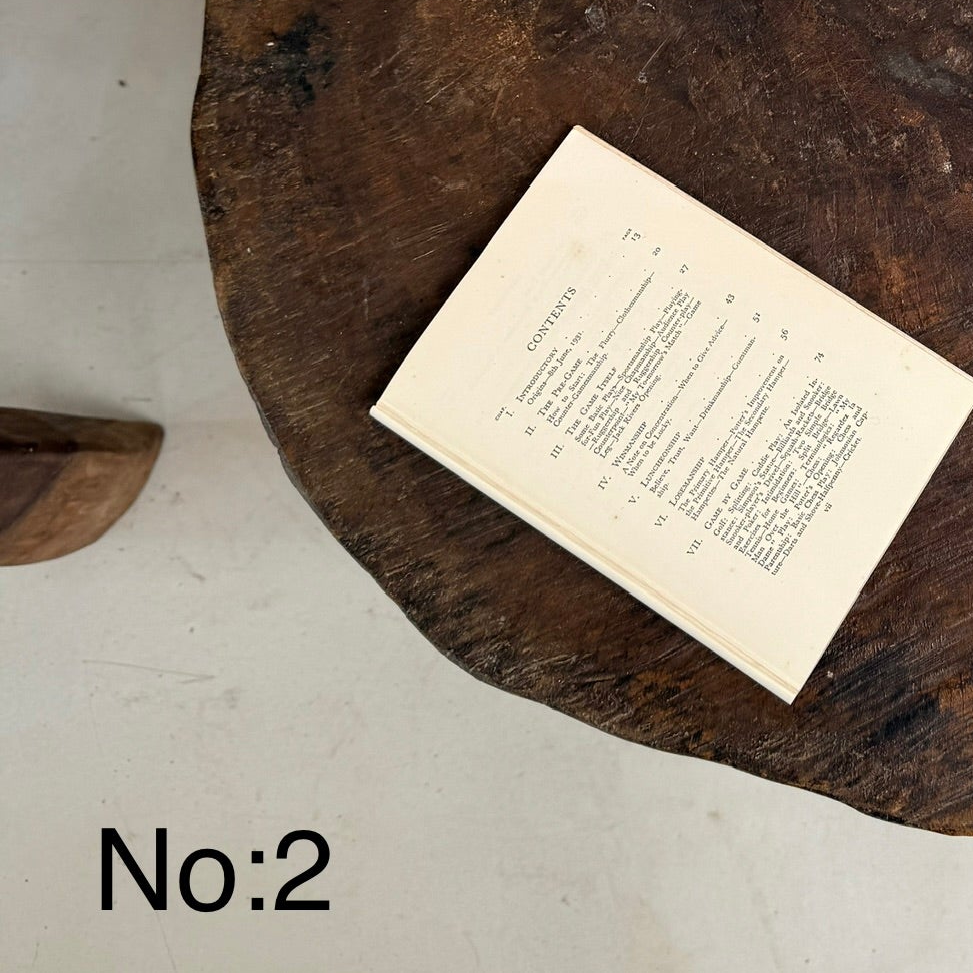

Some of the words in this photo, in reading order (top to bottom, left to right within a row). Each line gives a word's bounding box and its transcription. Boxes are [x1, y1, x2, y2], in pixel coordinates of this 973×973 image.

[504, 410, 516, 418] I.
[514, 346, 559, 403] INTRODUCTORY
[630, 231, 642, 242] 13
[526, 286, 577, 352] CONTENTS
[696, 346, 711, 364] Give
[545, 405, 561, 424] How
[560, 395, 570, 403] to
[568, 371, 586, 393] Start:
[585, 352, 599, 367] The
[549, 444, 565, 460] III.
[564, 418, 582, 436] THE
[579, 393, 600, 416] GAME
[595, 366, 617, 392] ITSELF
[678, 263, 690, 275] 27
[552, 352, 609, 428] Counter-Gamesmanship.
[555, 347, 573, 367] June,
[580, 421, 602, 447] for-Fun
[676, 291, 690, 308] Play
[597, 475, 612, 491] IV.
[610, 420, 648, 468] WINMANSHIP
[724, 293, 736, 305] 43
[621, 388, 633, 403] and
[632, 348, 661, 385] Ruggership
[691, 363, 700, 372] to
[523, 425, 538, 437] II.
[536, 399, 554, 417] THE
[550, 357, 584, 398] PRE-GAME
[574, 423, 591, 443] Some
[587, 404, 604, 423] Basic
[622, 402, 641, 426] Rivers
[638, 374, 662, 403] Opening.
[627, 494, 641, 504] V.
[639, 430, 681, 489] LUNCHEONSHIP
[751, 311, 762, 324] 51
[653, 514, 669, 527] VI.
[667, 456, 705, 508] LOSEMANSHIP
[779, 327, 789, 342] 56
[621, 467, 630, 475] A
[625, 449, 641, 467] Note
[626, 458, 645, 478] When
[641, 449, 650, 458] to
[646, 440, 657, 450] be
[652, 418, 673, 441] Lucky.
[648, 468, 671, 494] Believe,
[666, 446, 686, 465] Trust,
[684, 504, 696, 517] the
[691, 473, 716, 505] Primitive
[743, 392, 770, 427] Secondary
[685, 538, 704, 555] VII.
[703, 506, 724, 531] GAME
[721, 492, 732, 506] BY
[729, 467, 749, 491] GAME
[813, 351, 826, 364] 74
[712, 517, 729, 537] Golf:
[727, 481, 752, 515] Splitting:
[751, 453, 770, 478] Caddie
[767, 433, 784, 453] Play:
[782, 418, 794, 430] An
[790, 389, 811, 417] Isolated
[719, 516, 739, 543] stance:
[794, 410, 806, 426] and
[802, 381, 825, 411] Snooker:
[726, 438, 748, 466] Natural
[744, 405, 771, 440] Hampette.
[732, 534, 745, 551] and
[742, 509, 762, 533] Poker:
[760, 459, 793, 505] Intimidation:
[791, 439, 806, 455] Two
[820, 389, 838, 412] Bridge
[776, 516, 794, 537] Play:
[812, 448, 837, 481] Opening:
[836, 424, 852, 443] Chess
[851, 404, 863, 421] and
[677, 498, 691, 512] The
[688, 468, 711, 497] Primary
[737, 523, 762, 555] Exercises
[760, 507, 772, 520] for
[770, 467, 798, 504] Beginners:
[797, 444, 813, 461] Split
[750, 546, 766, 564] Man
[764, 523, 780, 542] Over
[779, 507, 790, 520] the
[847, 402, 857, 411] la
[763, 532, 793, 572] Parentship:
[789, 510, 806, 530] Basic
[803, 489, 820, 510] Chess
[816, 468, 833, 489] Play:
[830, 429, 858, 468] Johnsonian
[855, 410, 869, 428] Cap-
[779, 478, 800, 505] Games:
[823, 501, 833, 513] vii
[796, 521, 808, 538] and
